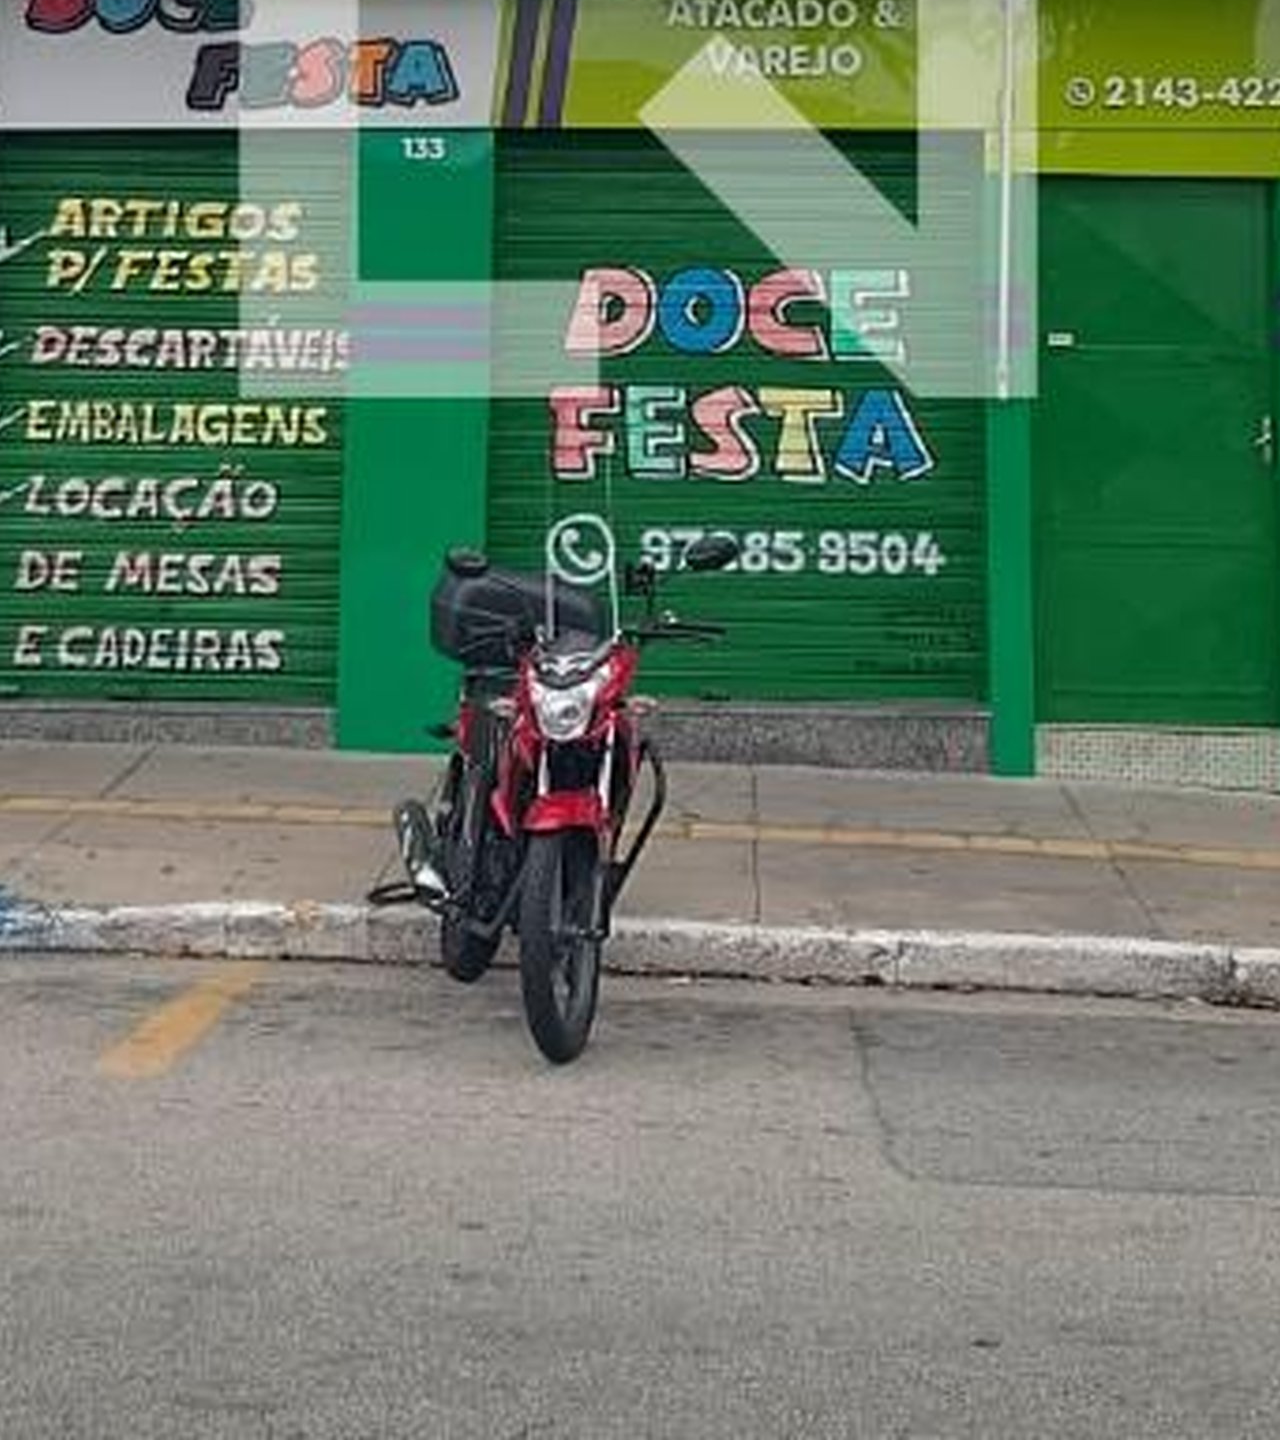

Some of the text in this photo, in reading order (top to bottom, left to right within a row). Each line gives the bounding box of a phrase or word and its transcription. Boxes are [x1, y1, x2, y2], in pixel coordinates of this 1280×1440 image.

[872, 0, 904, 29] &
[186, 38, 459, 111] FESTA
[706, 44, 862, 77] VAREJO
[402, 137, 446, 160] 133
[49, 197, 304, 241] ARTIGOS
[564, 266, 910, 361] DOCE
[24, 400, 329, 446] EMBALAGENS
[549, 385, 935, 486] FESTA
[24, 463, 278, 534] LOCAÇÃO
[15, 550, 282, 596] DE MESAS
[14, 624, 287, 670] E CADEIRAS
